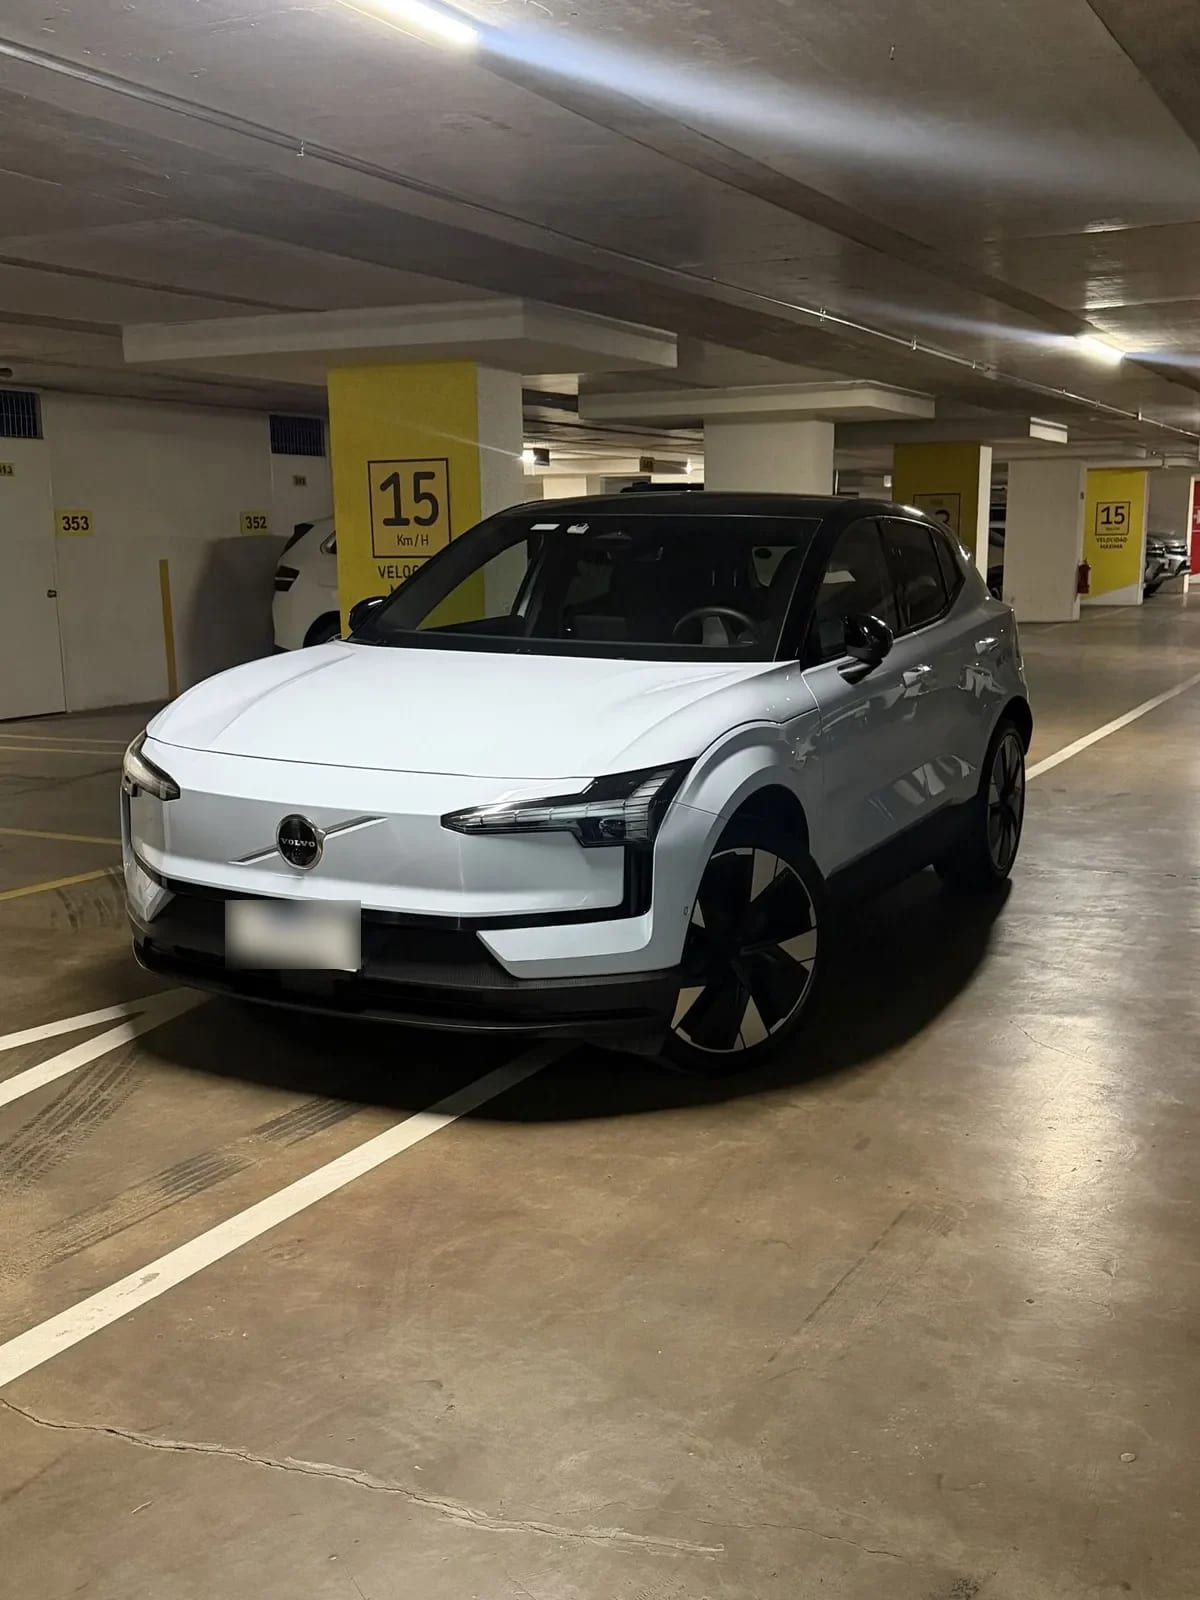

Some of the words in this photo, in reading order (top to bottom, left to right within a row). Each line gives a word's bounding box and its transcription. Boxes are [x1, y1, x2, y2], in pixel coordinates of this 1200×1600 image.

[380, 471, 439, 526] 15
[62, 515, 89, 531] 353
[245, 515, 267, 529] 352
[1100, 505, 1125, 525] 15
[279, 837, 316, 848] VOLVO
